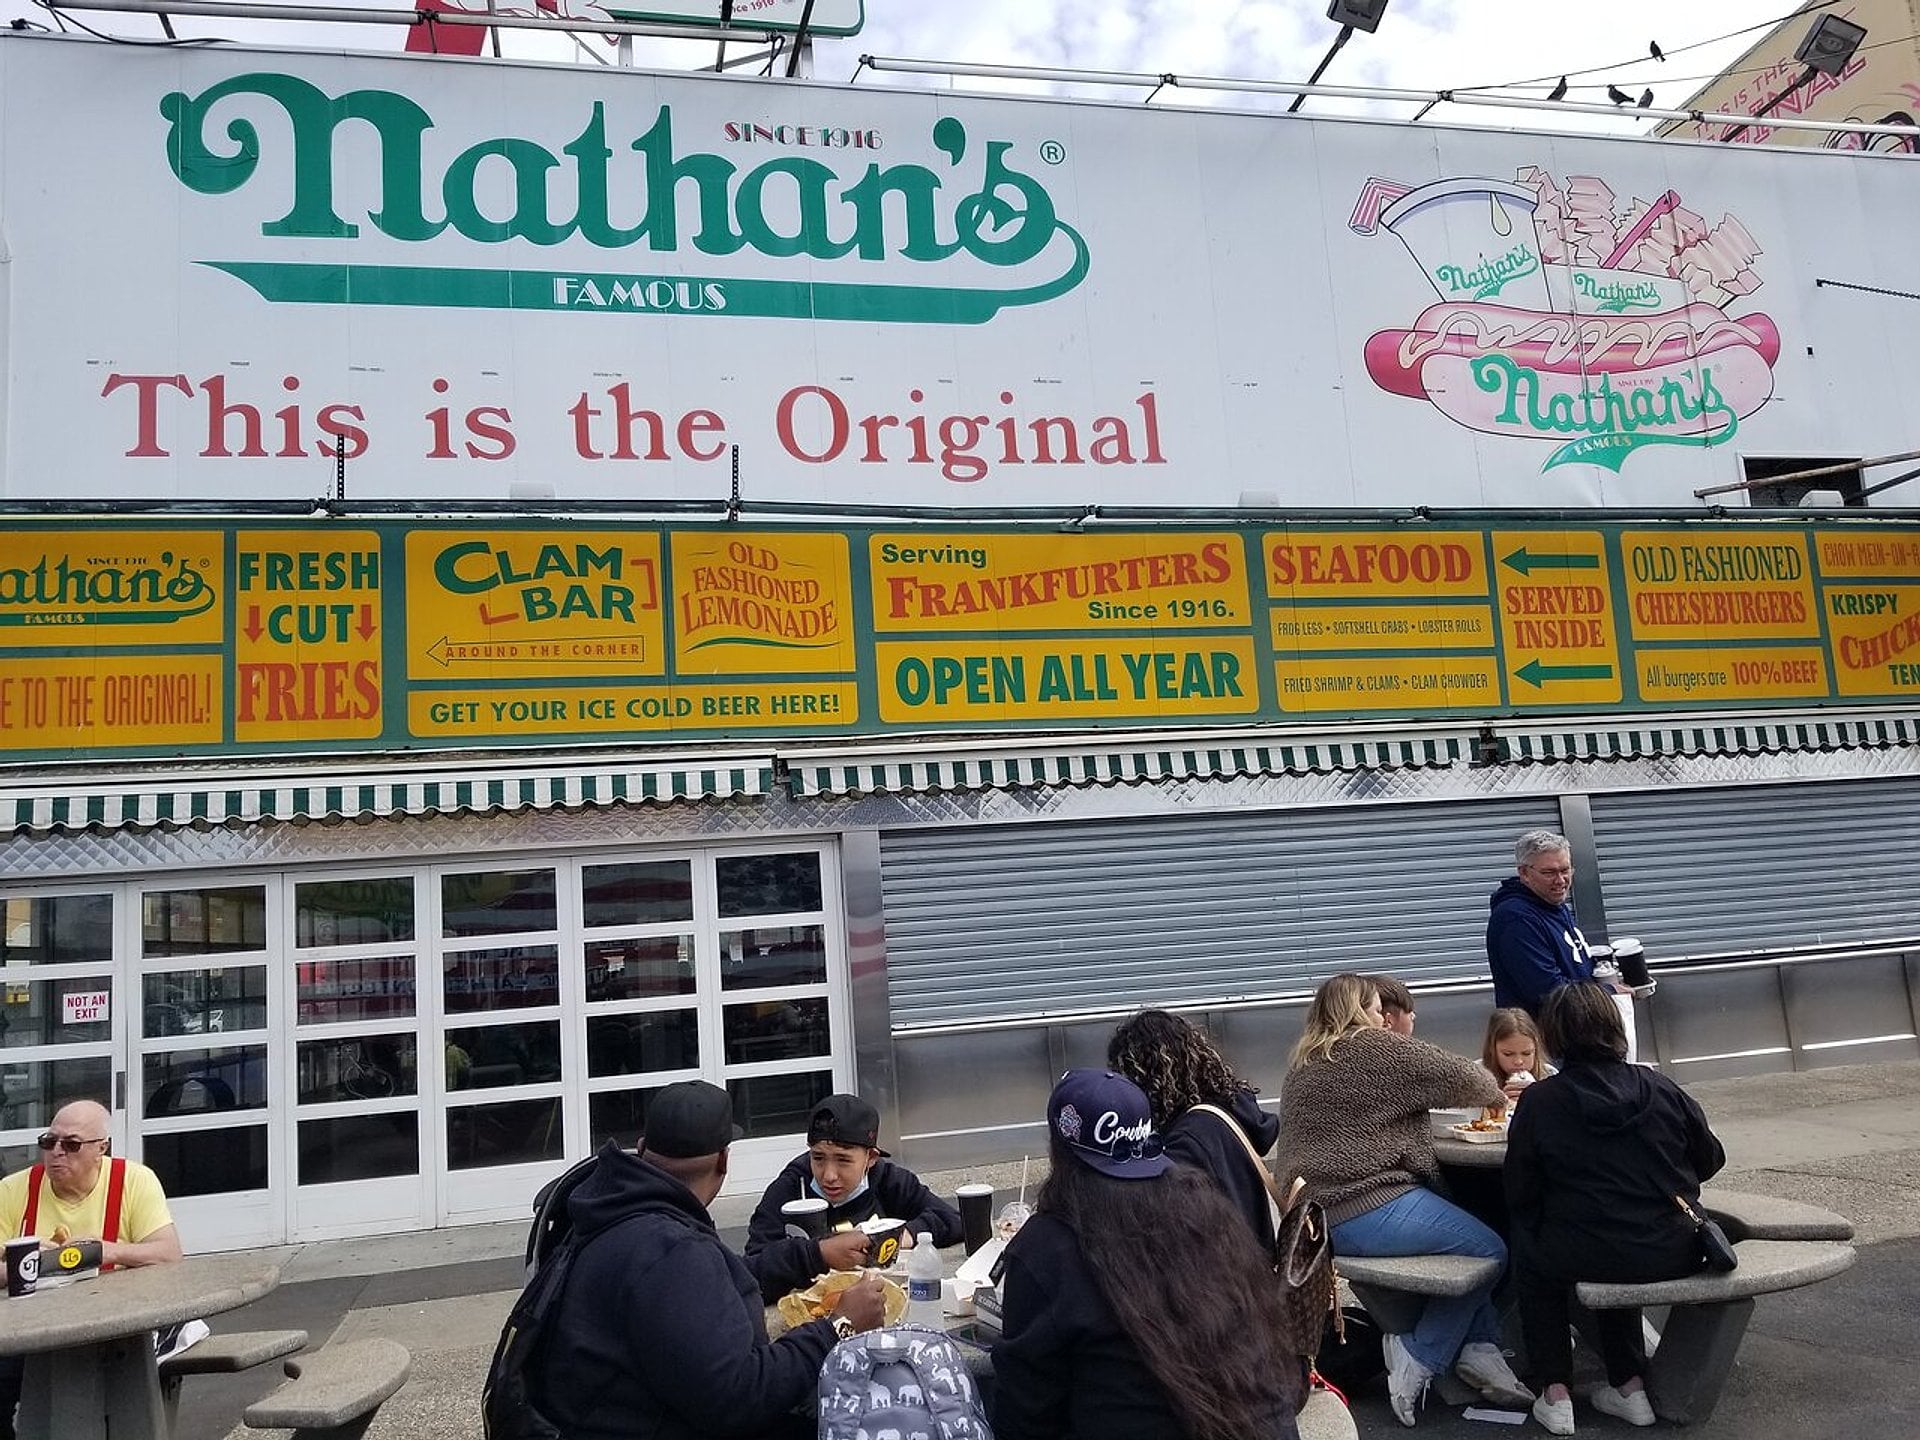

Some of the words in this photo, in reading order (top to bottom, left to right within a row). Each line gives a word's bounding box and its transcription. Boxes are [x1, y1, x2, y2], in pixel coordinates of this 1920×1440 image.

[1751, 57, 1789, 91] THE
[724, 121, 815, 147] SINCE
[819, 127, 883, 149] 1916
[1436, 243, 1534, 292] Nathan's
[553, 277, 726, 311] FAMOUS
[1574, 272, 1658, 300] Nathan's
[1470, 354, 1724, 434] Nathan's
[101, 373, 369, 458] This
[425, 378, 517, 460] is
[567, 382, 728, 461] the
[776, 384, 1168, 483] Original
[433, 541, 623, 595] CLAM
[728, 541, 779, 572] OLD
[881, 543, 987, 568] Serving
[1272, 544, 1473, 585] SEAFOOD
[1632, 546, 1677, 582] OLD
[1681, 546, 1801, 581] FASHIONED
[1824, 543, 1855, 567] CHOW
[239, 552, 378, 591] FRESH
[691, 567, 820, 605] FASHIONED
[887, 543, 1232, 619] FRANKFURTERS
[521, 584, 636, 623] BAR
[680, 590, 838, 639] LEMONADE
[1088, 600, 1158, 620] Since
[1167, 600, 1235, 618] 1916.
[1506, 586, 1605, 614] SERVED
[1635, 591, 1807, 625] CHEESEBURGERS
[1831, 594, 1898, 615] KRISPY
[24, 613, 86, 624] FAMOUS
[268, 604, 353, 643] CUT
[1278, 622, 1300, 636] FROG
[1302, 622, 1323, 636] LEGS
[1333, 621, 1378, 634] SOFTSHELL
[1381, 620, 1409, 634] CRABS
[1418, 620, 1453, 633] LOBSTER
[1455, 619, 1482, 633] ROLLS
[1514, 620, 1605, 649] INSIDE
[445, 645, 519, 659] AROUND
[530, 645, 561, 657] THE
[571, 643, 640, 656] CORNER
[895, 656, 1026, 706] OPEN
[1038, 654, 1117, 702] ALL
[1121, 652, 1244, 700] YEAR
[1284, 677, 1311, 693] FRIED
[1314, 676, 1353, 692] SHRIMP
[1356, 677, 1364, 690] &
[1366, 675, 1400, 690] CLAMS
[1411, 675, 1438, 689] CLAM
[1441, 673, 1488, 688] CHOWDER
[1647, 666, 1661, 688] All
[1664, 667, 1706, 692] burgers
[1708, 672, 1727, 685] are
[1731, 662, 1781, 686] 100%
[1783, 660, 1818, 685] BEEF
[22, 677, 47, 729] TO
[54, 676, 96, 728] THE
[103, 673, 212, 726] ORIGINAL!
[237, 660, 379, 722] FRIES
[430, 702, 480, 723] GET
[490, 699, 567, 721] YOUR
[578, 698, 616, 719] ICE
[626, 698, 692, 718] COLD
[702, 696, 761, 716] BEER
[771, 694, 840, 714] HERE!
[67, 997, 88, 1007] NOT
[91, 995, 106, 1005] AN
[75, 1008, 97, 1019] EXIT
